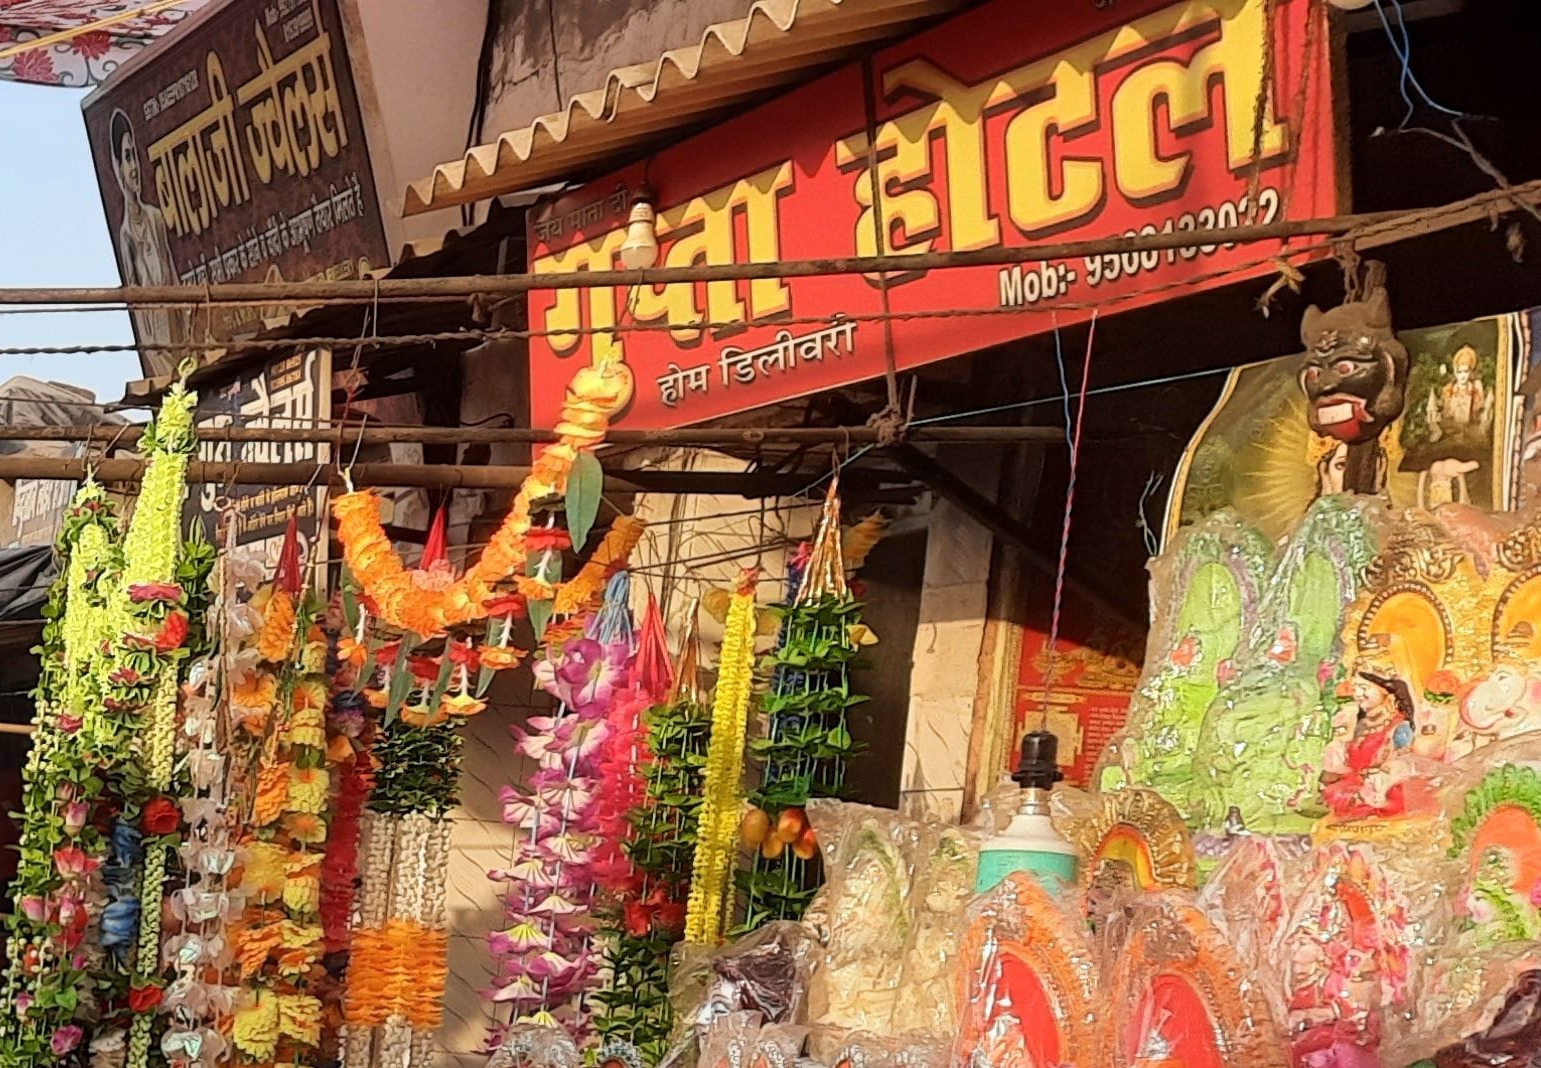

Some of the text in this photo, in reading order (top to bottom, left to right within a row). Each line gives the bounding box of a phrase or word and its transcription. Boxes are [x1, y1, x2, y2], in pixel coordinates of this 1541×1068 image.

[147, 51, 251, 238] बालाजी
[835, 0, 1288, 285] होटल
[534, 184, 628, 242] जय माता दी
[999, 261, 1077, 307] Mob:-
[657, 313, 857, 407] होम डिलीवरी
